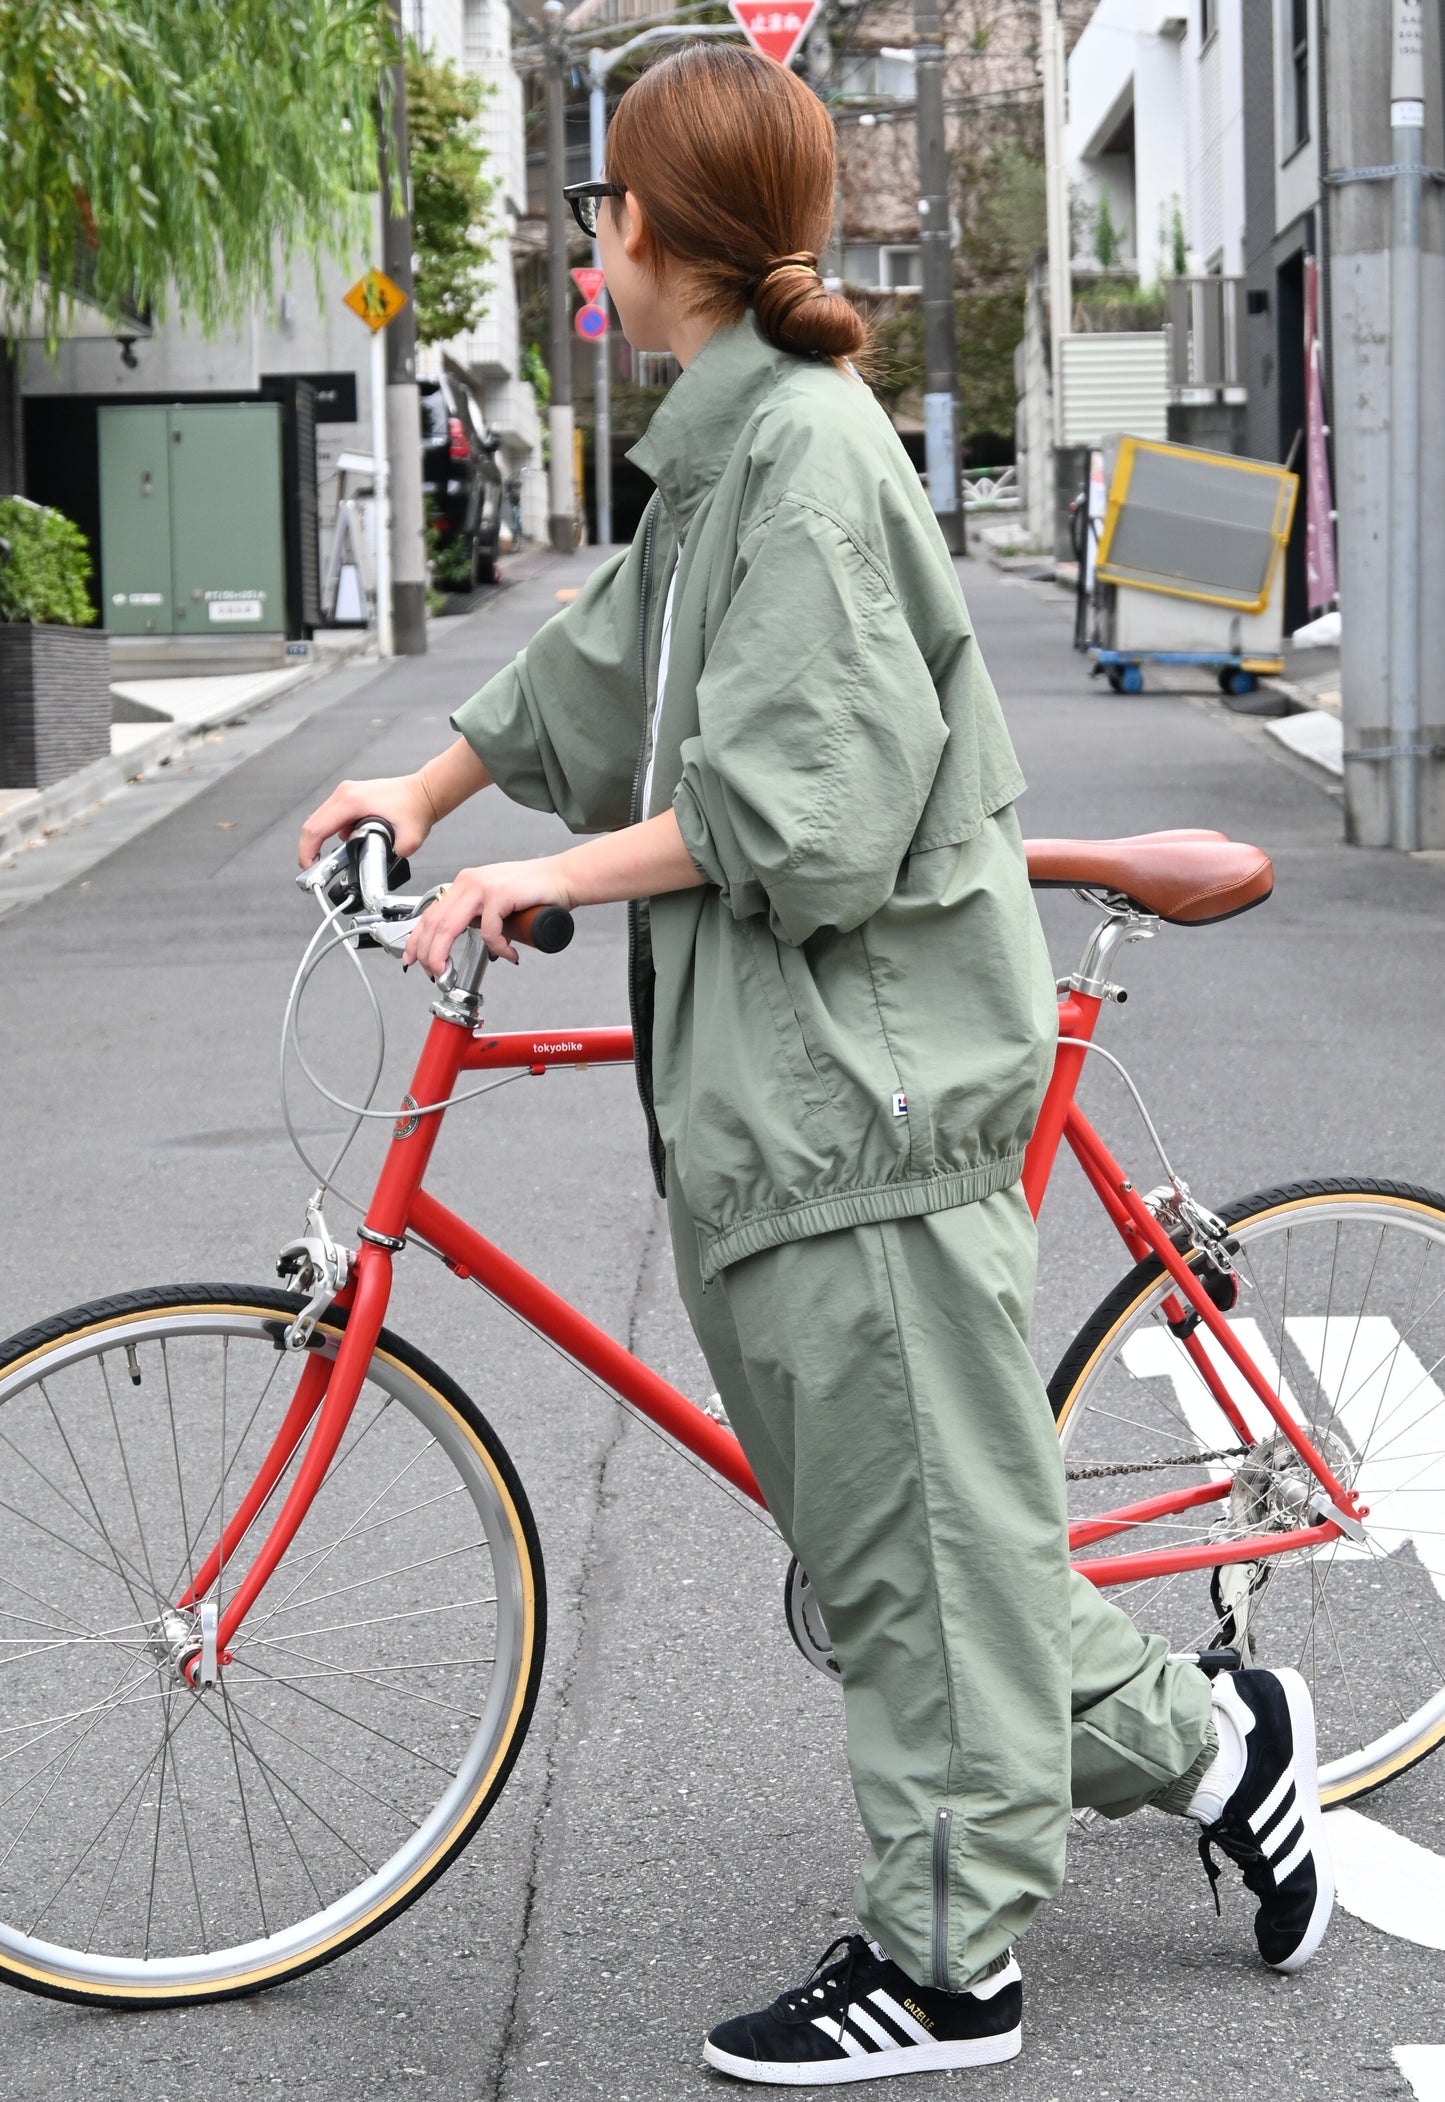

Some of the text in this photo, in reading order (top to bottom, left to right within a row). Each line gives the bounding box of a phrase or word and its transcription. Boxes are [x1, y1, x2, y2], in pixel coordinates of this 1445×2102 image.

[750, 12, 801, 32] 止まれ
[533, 1042, 583, 1054] tokyobike
[903, 1998, 935, 2030] GAZELLE
